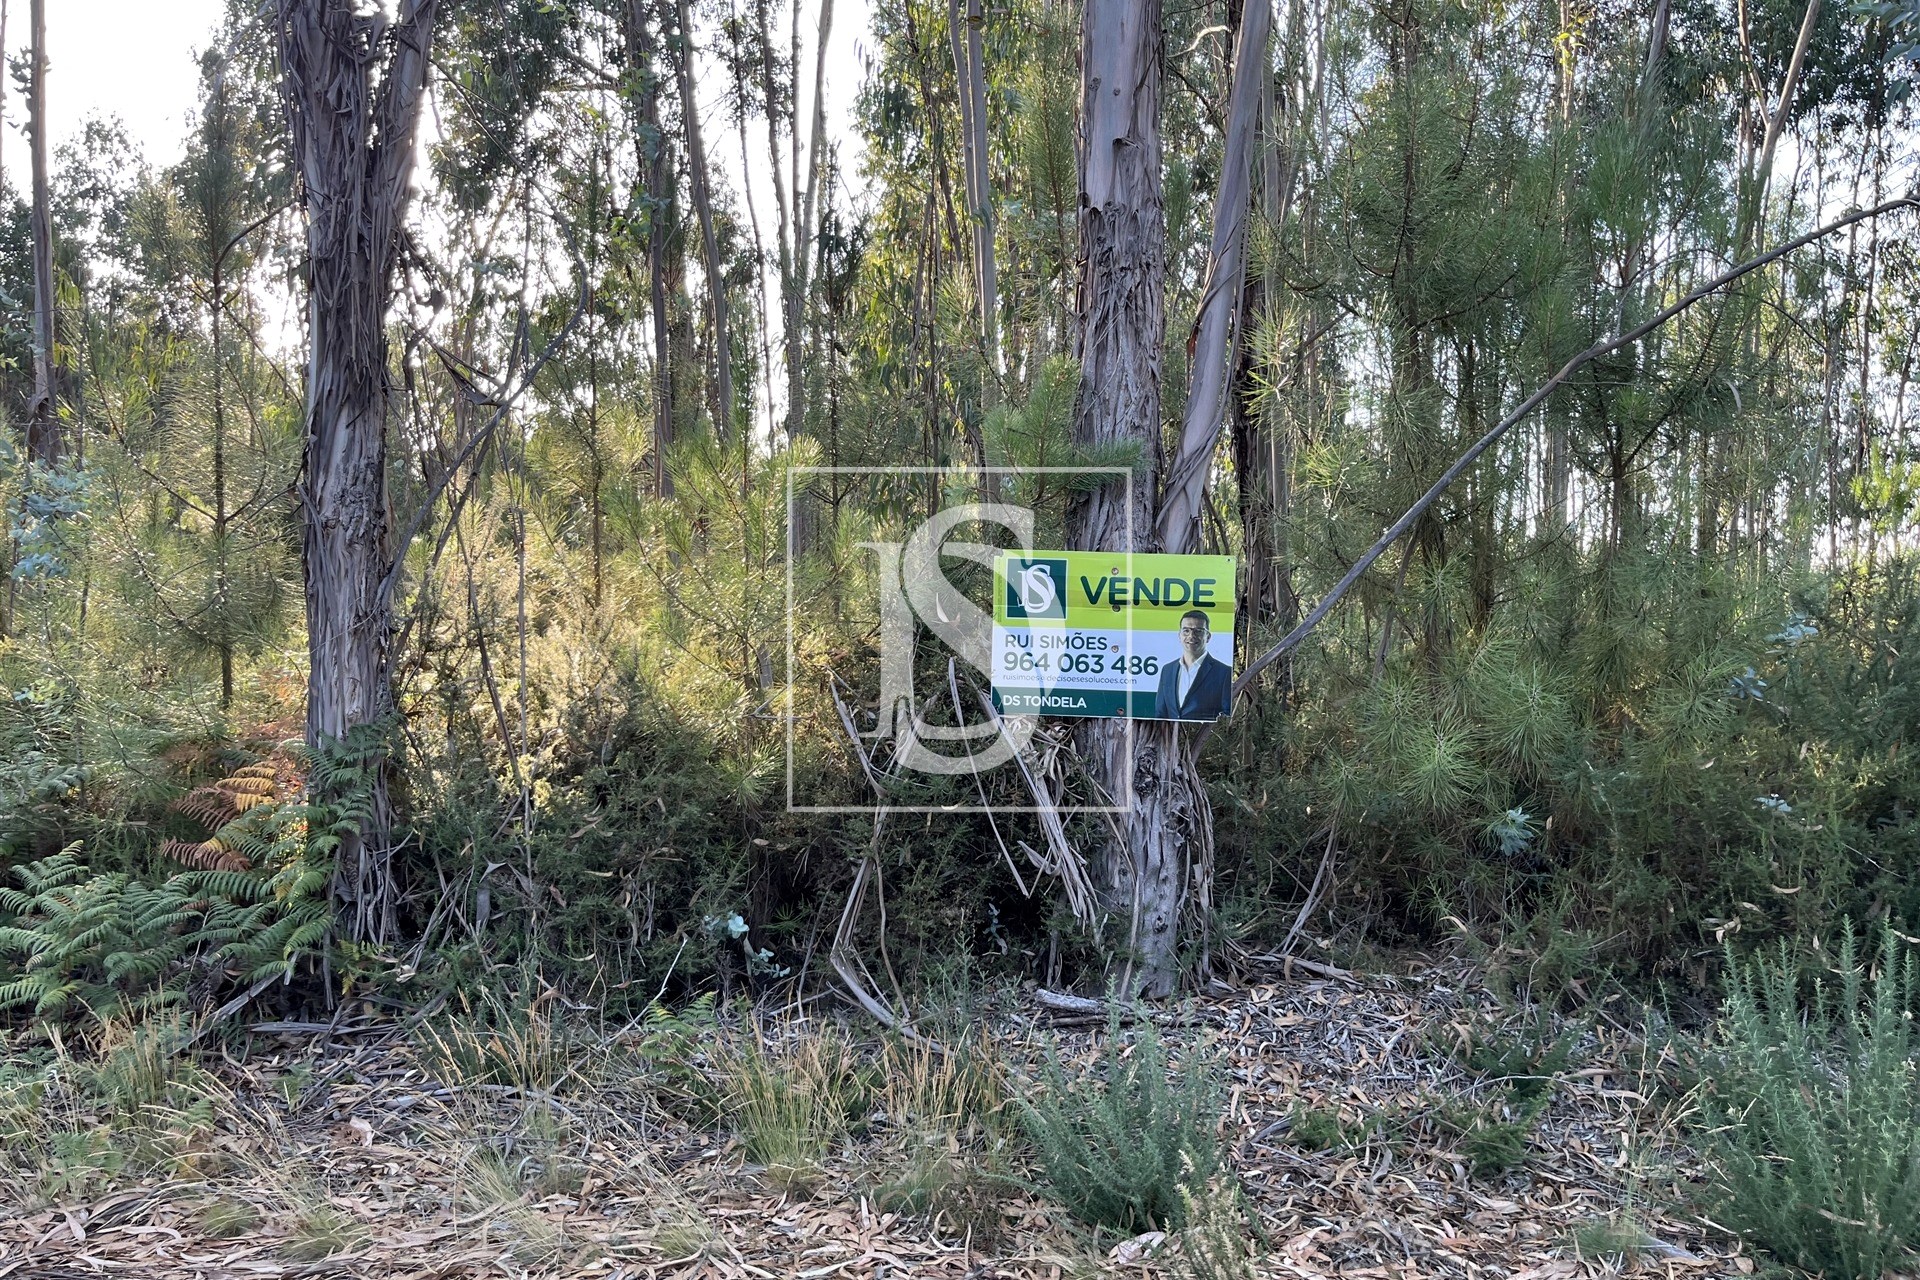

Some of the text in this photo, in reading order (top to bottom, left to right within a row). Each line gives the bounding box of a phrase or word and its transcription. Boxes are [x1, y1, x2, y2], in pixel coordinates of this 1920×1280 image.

[1080, 575, 1217, 608] VENDE
[1005, 632, 1108, 651] RUI SIMÕES
[1004, 652, 1159, 676] 964 063 486
[1003, 694, 1087, 709] DS TONDELA
